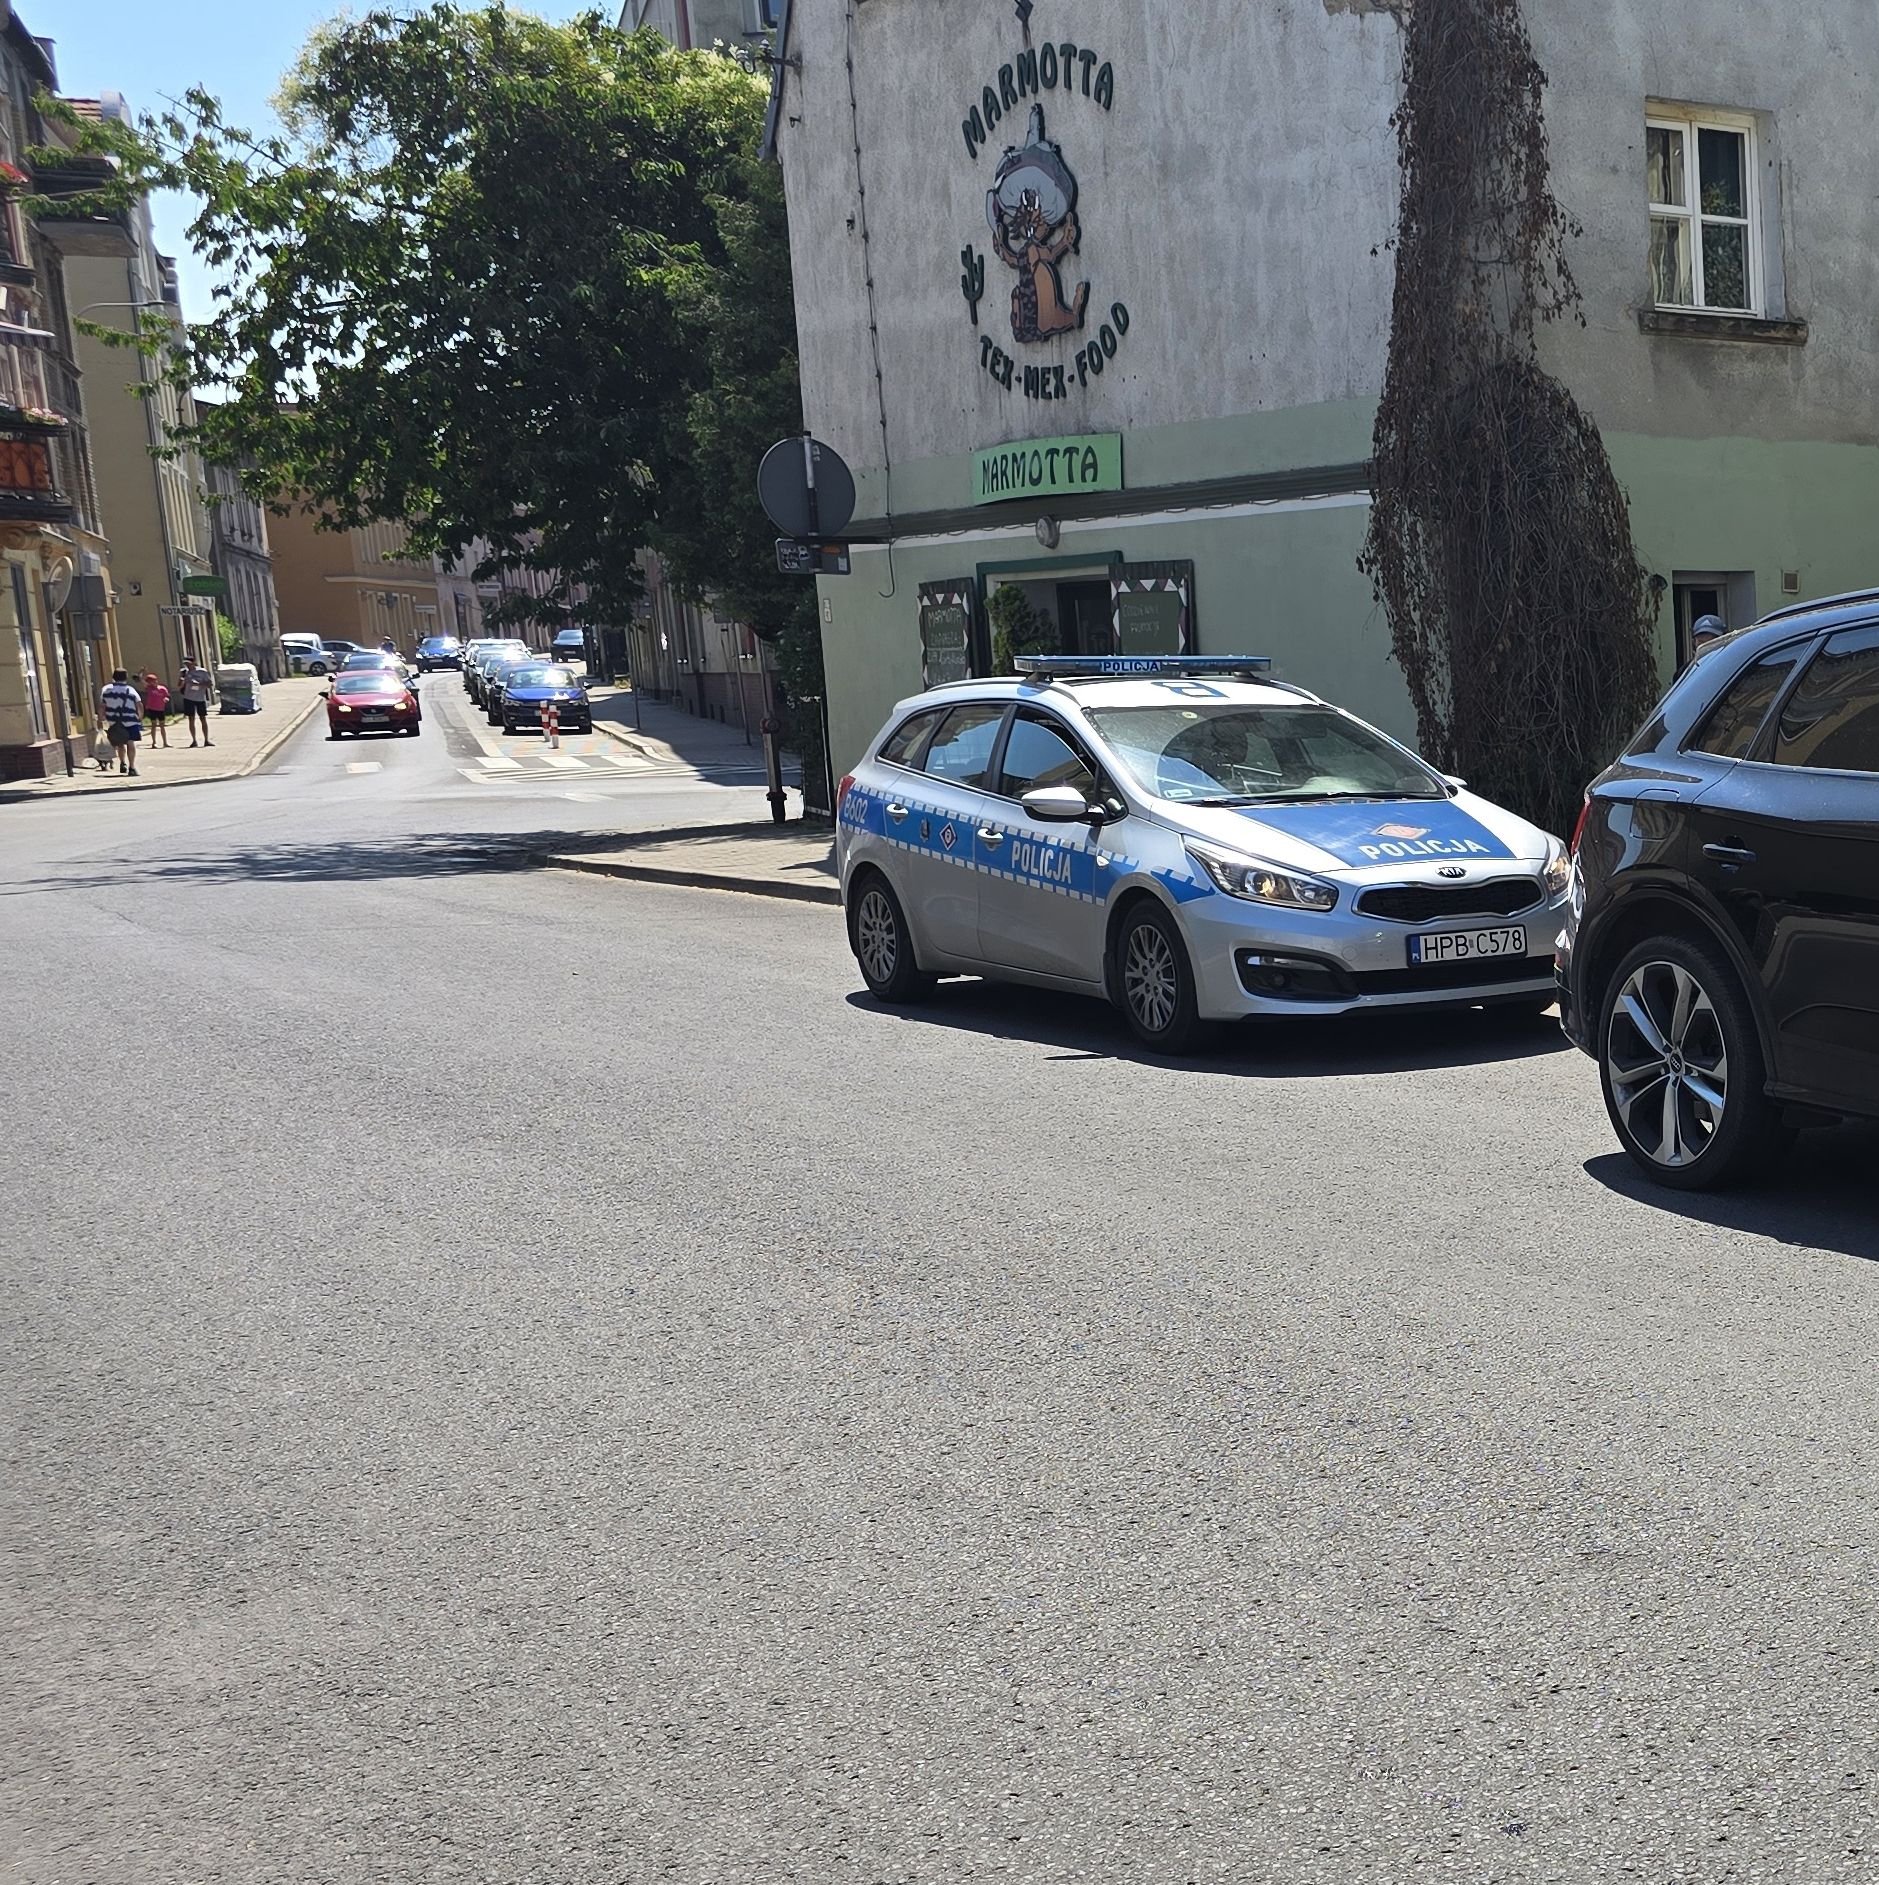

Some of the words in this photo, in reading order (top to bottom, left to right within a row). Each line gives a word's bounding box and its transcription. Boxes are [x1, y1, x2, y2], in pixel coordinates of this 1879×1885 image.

[961, 42, 1114, 159] MARMOTTA
[980, 445, 1099, 496] MARMOTTA
[161, 607, 207, 616] NOTARIUSZ
[1102, 661, 1161, 672] POLICJA
[1011, 840, 1072, 884] POLICJA
[1357, 839, 1491, 860] POLICJA
[1424, 935, 1469, 960] HPB
[1476, 929, 1523, 954] C578
